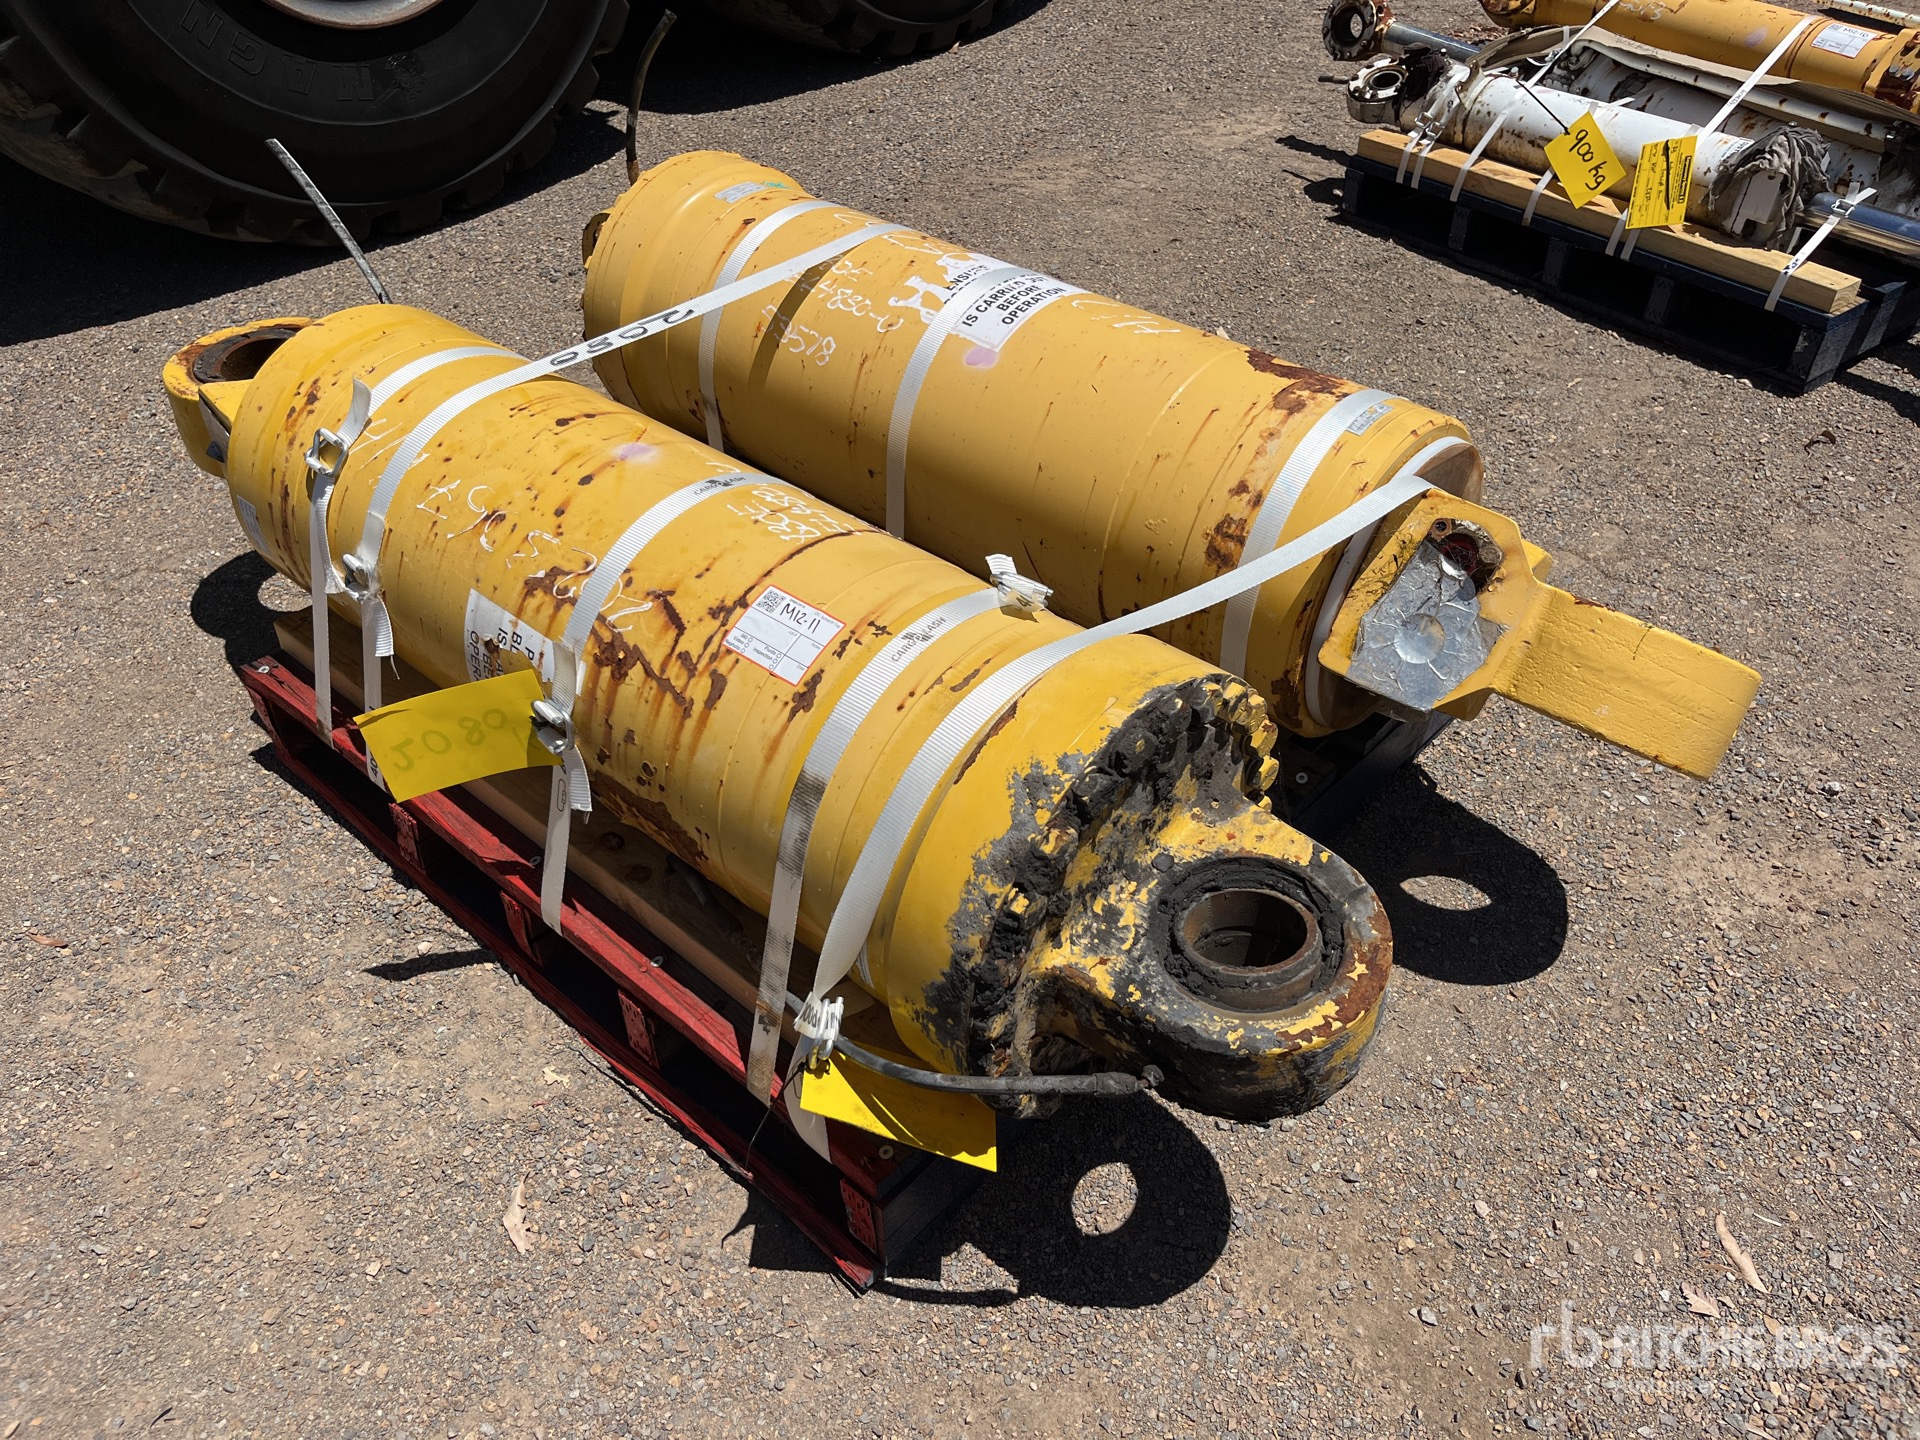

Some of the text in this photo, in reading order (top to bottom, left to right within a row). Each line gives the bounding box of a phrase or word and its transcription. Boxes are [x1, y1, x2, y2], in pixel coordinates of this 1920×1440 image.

[1568, 129, 1594, 163] 900
[962, 314, 979, 327] IS
[1001, 286, 1067, 326] OPERATION
[779, 602, 821, 634] M12-11
[753, 647, 773, 661] Inspection
